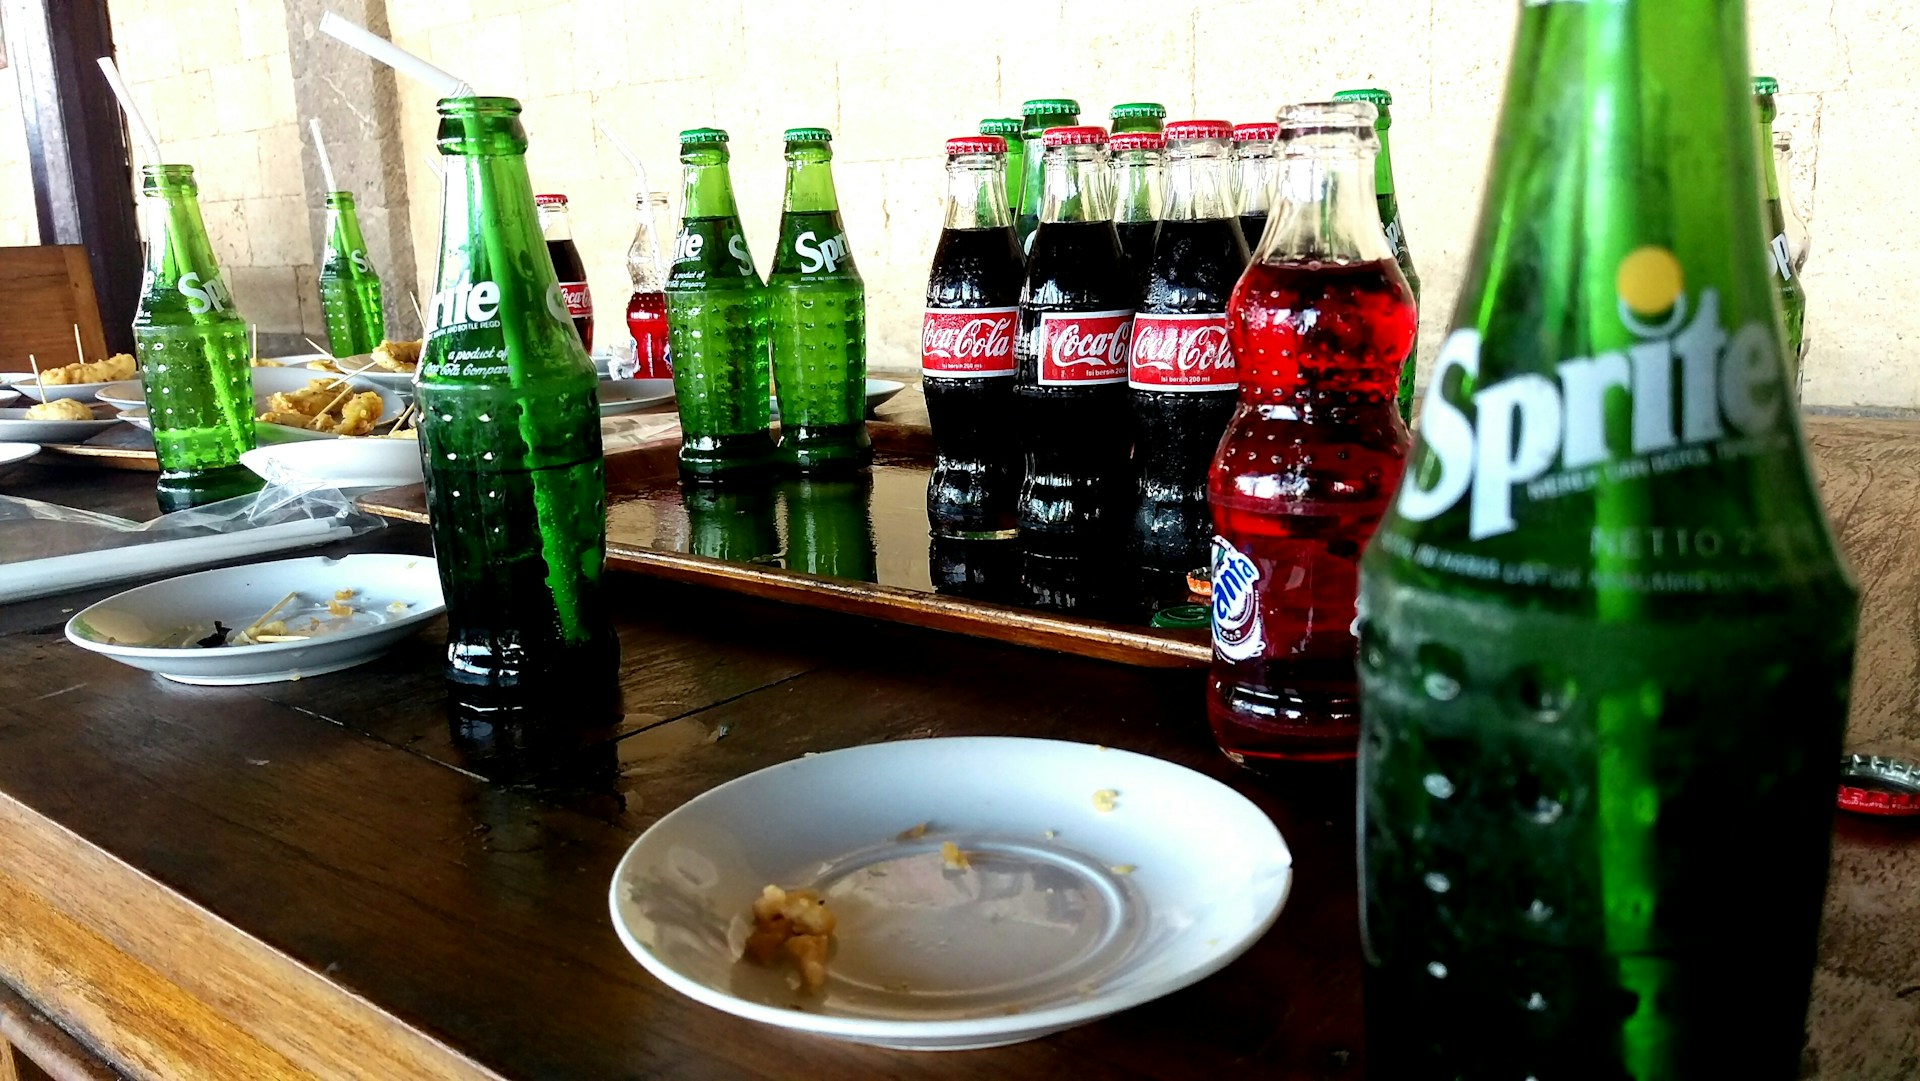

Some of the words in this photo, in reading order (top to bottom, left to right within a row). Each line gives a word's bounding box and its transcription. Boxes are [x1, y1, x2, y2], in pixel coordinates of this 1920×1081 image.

[453, 345, 496, 363] product
[496, 345, 511, 361] of
[923, 318, 1011, 358] Coca-Cola
[1396, 245, 1783, 541] Sprite
